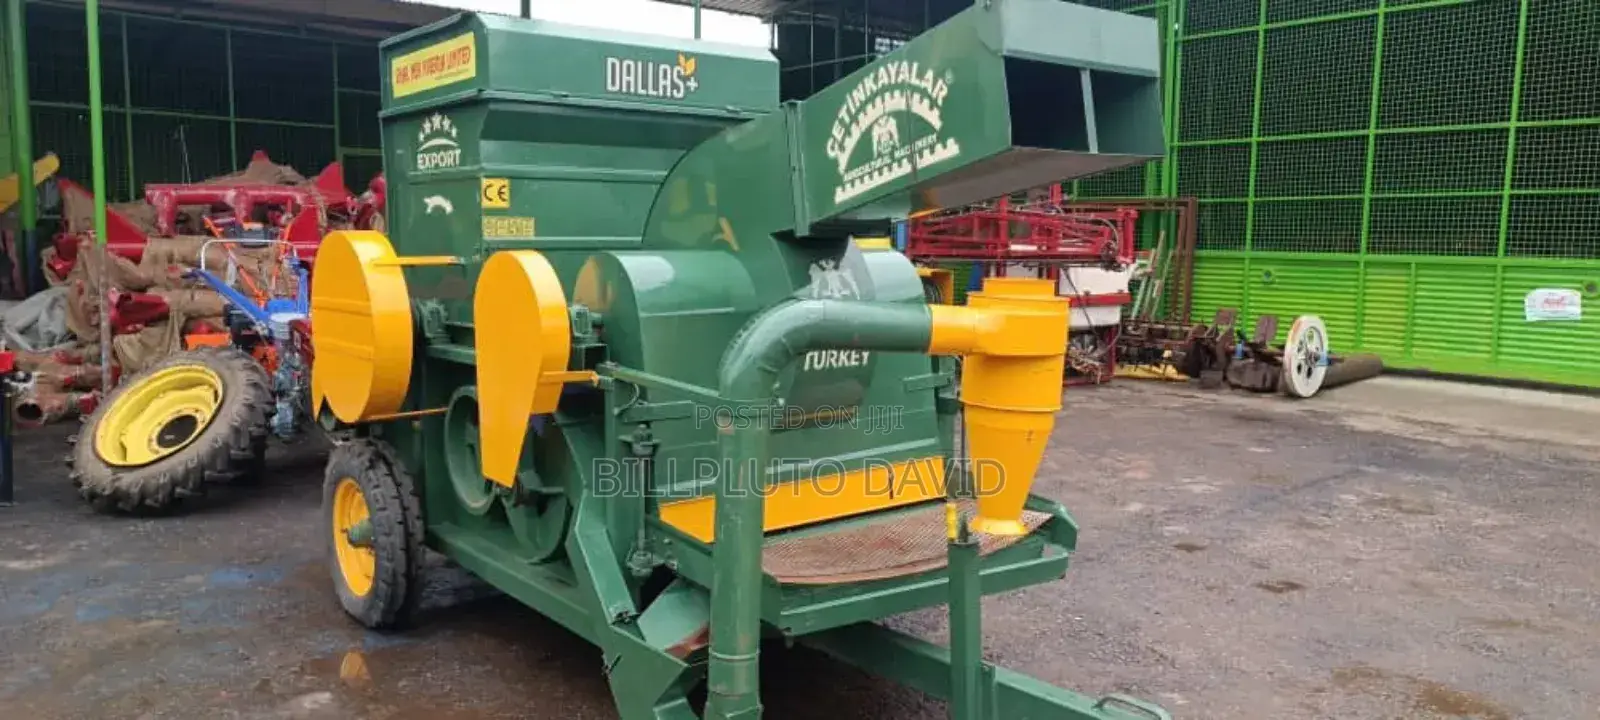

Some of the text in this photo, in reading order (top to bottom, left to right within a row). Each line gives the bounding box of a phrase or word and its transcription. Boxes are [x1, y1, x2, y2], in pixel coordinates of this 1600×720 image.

[417, 149, 461, 169] EXPORT
[484, 183, 506, 202] CE
[804, 350, 869, 371] TURKEY
